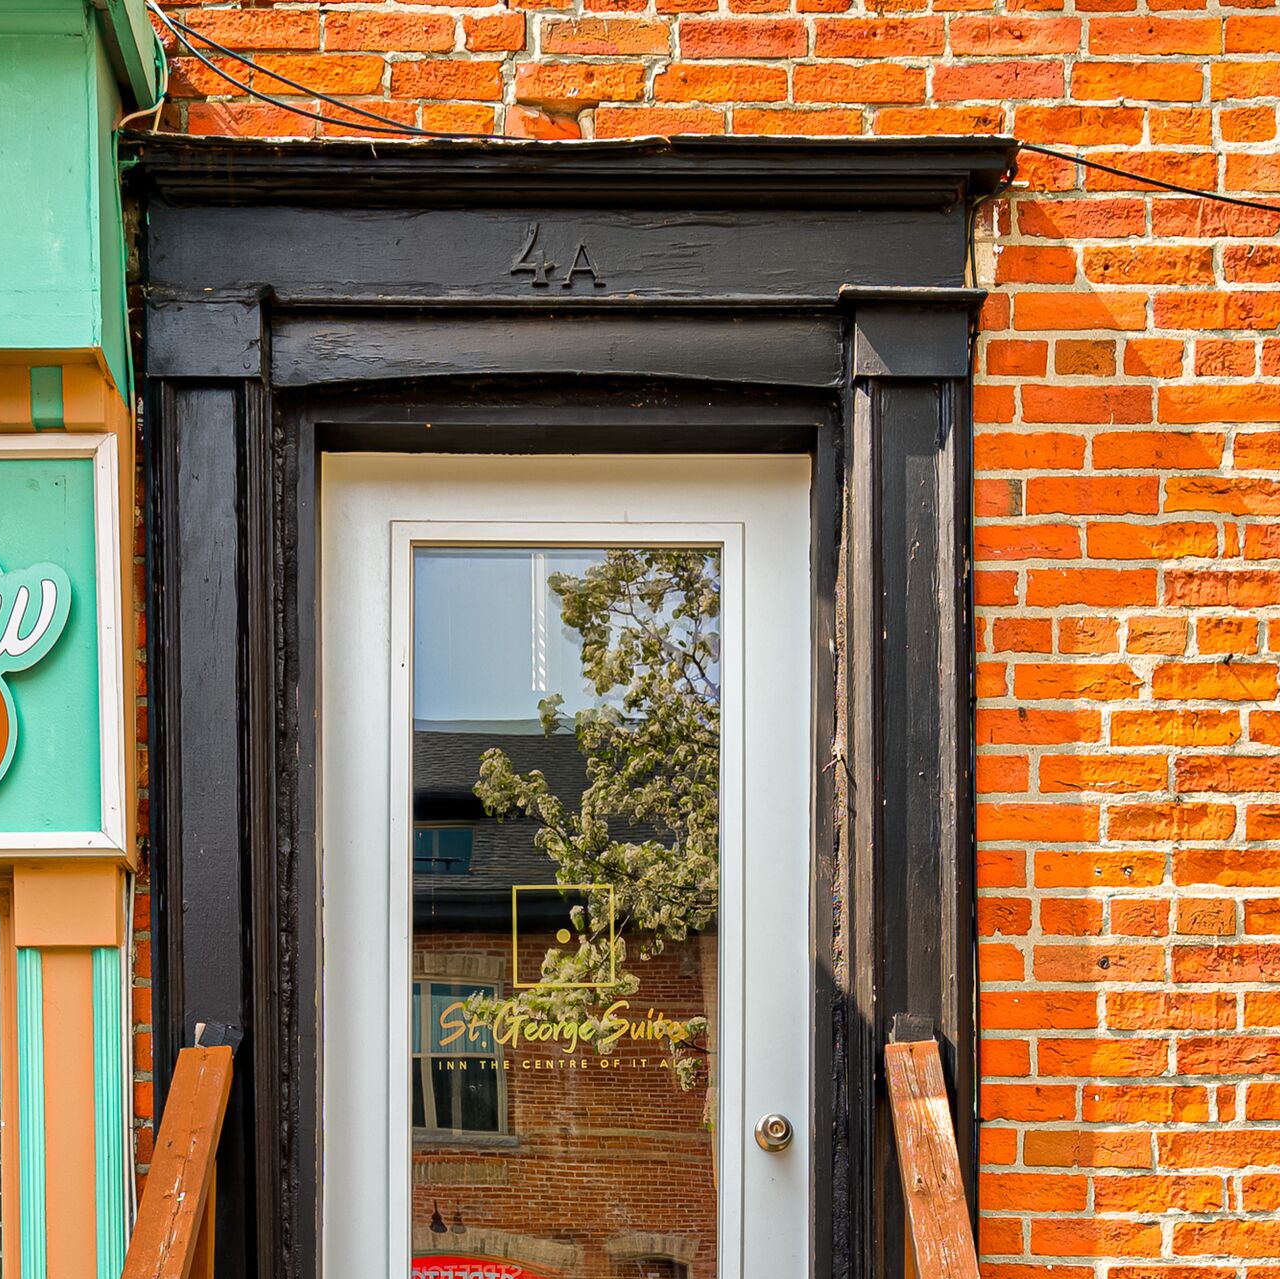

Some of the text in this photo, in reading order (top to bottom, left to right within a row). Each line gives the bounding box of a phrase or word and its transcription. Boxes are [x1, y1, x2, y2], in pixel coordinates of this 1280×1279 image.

[492, 1002, 596, 1053] George
[438, 1060, 468, 1070] INN
[479, 1060, 511, 1070] THE
[522, 1059, 589, 1069] CENTRE
[600, 1059, 621, 1069] OF
[631, 1059, 647, 1069] IT
